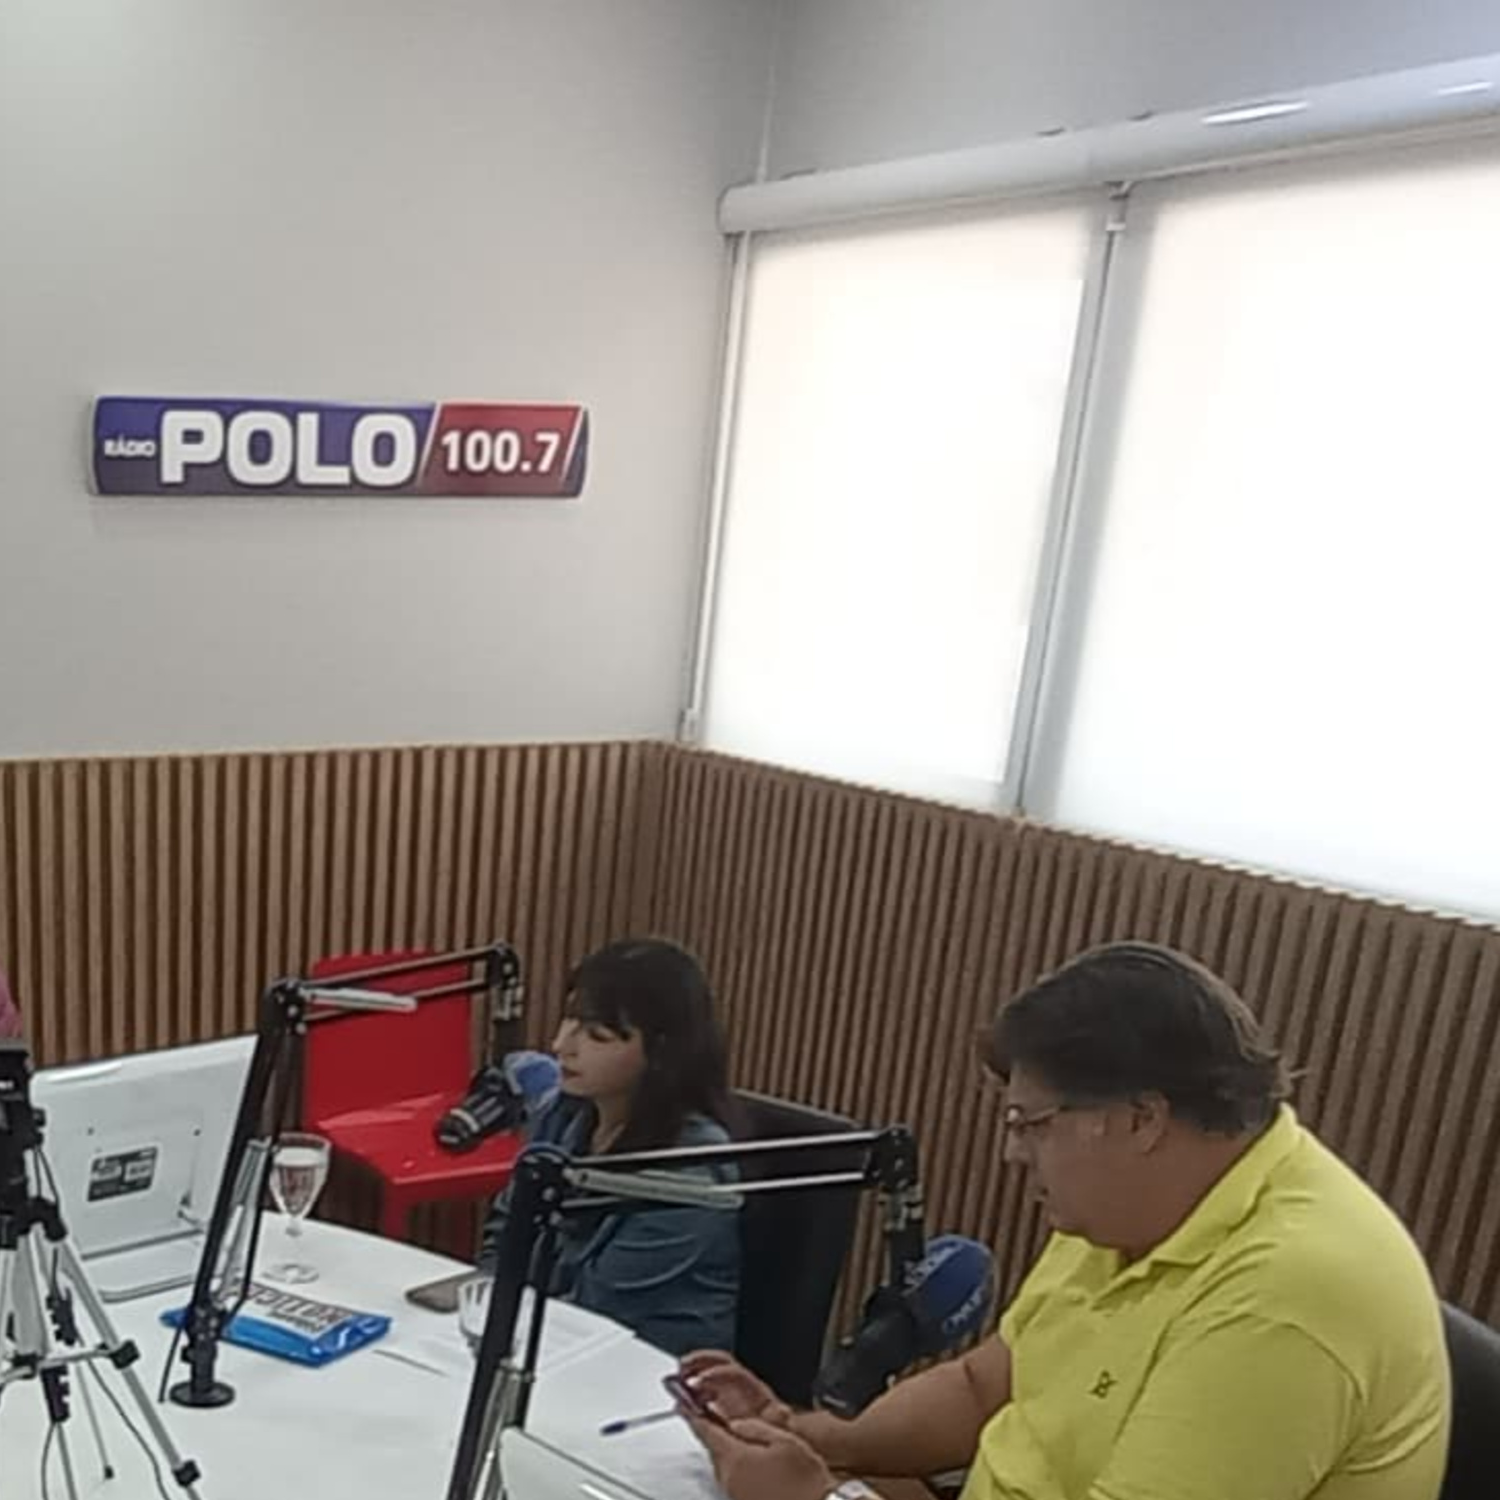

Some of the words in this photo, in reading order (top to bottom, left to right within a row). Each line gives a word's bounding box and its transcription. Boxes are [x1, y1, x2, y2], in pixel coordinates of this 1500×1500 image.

[104, 434, 156, 457] RÁDIO
[160, 410, 417, 486] POLO
[441, 430, 560, 474] 100.7
